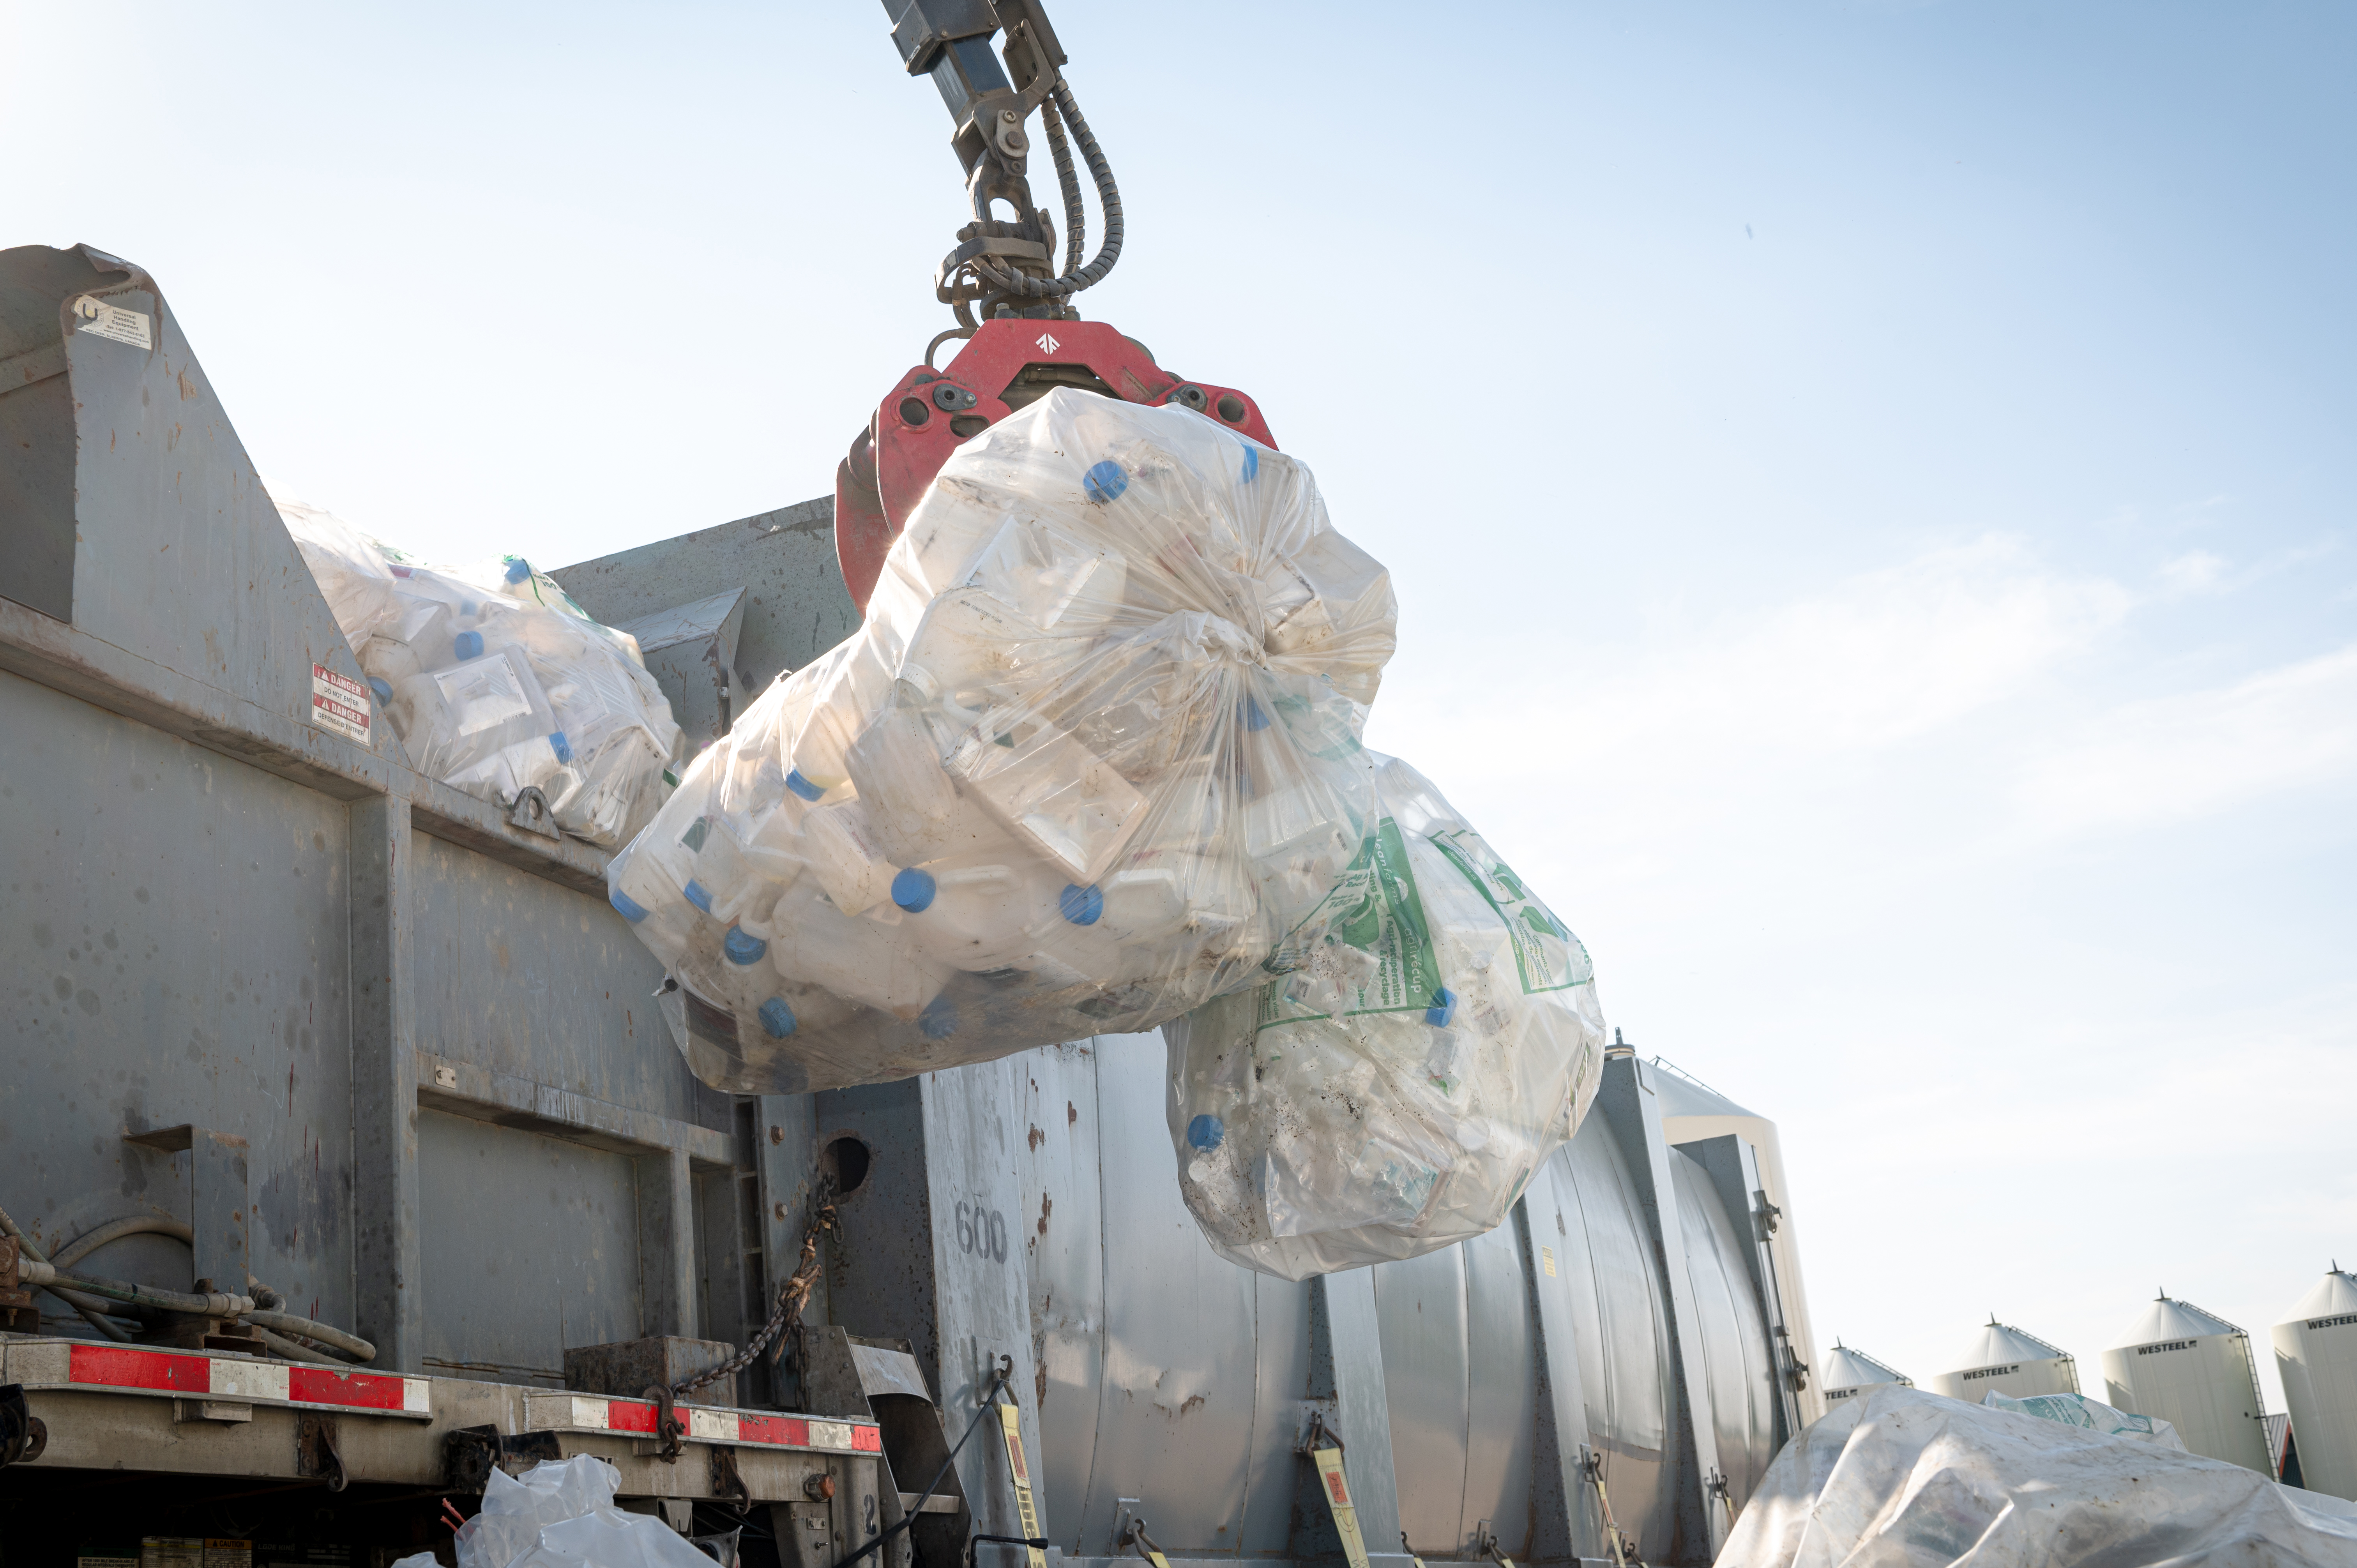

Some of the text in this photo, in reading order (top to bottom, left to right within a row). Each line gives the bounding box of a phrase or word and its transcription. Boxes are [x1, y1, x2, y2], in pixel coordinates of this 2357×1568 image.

[112, 320, 139, 331] Equipment
[113, 310, 136, 320] Universal
[113, 315, 136, 325] Handling
[331, 674, 361, 696] DANGER
[332, 691, 343, 699] NOT
[344, 696, 359, 707] ENTER
[318, 712, 364, 736] DEFENSE D'ENTRER
[332, 703, 361, 724] DANGER
[1375, 839, 1400, 904] leanfarms
[1447, 850, 1477, 881] cleanfarms.ca
[1404, 928, 1422, 993] agrirécup
[1533, 935, 1548, 968] Contenants
[1379, 957, 1390, 1006] recyclage
[956, 1201, 1007, 1264] 600
[2308, 1315, 2357, 1330] WESTEEL
[2138, 1341, 2187, 1355] WESTEEL
[1963, 1367, 2010, 1381] WESTEEL
[1825, 1390, 1848, 1400] TEEL
